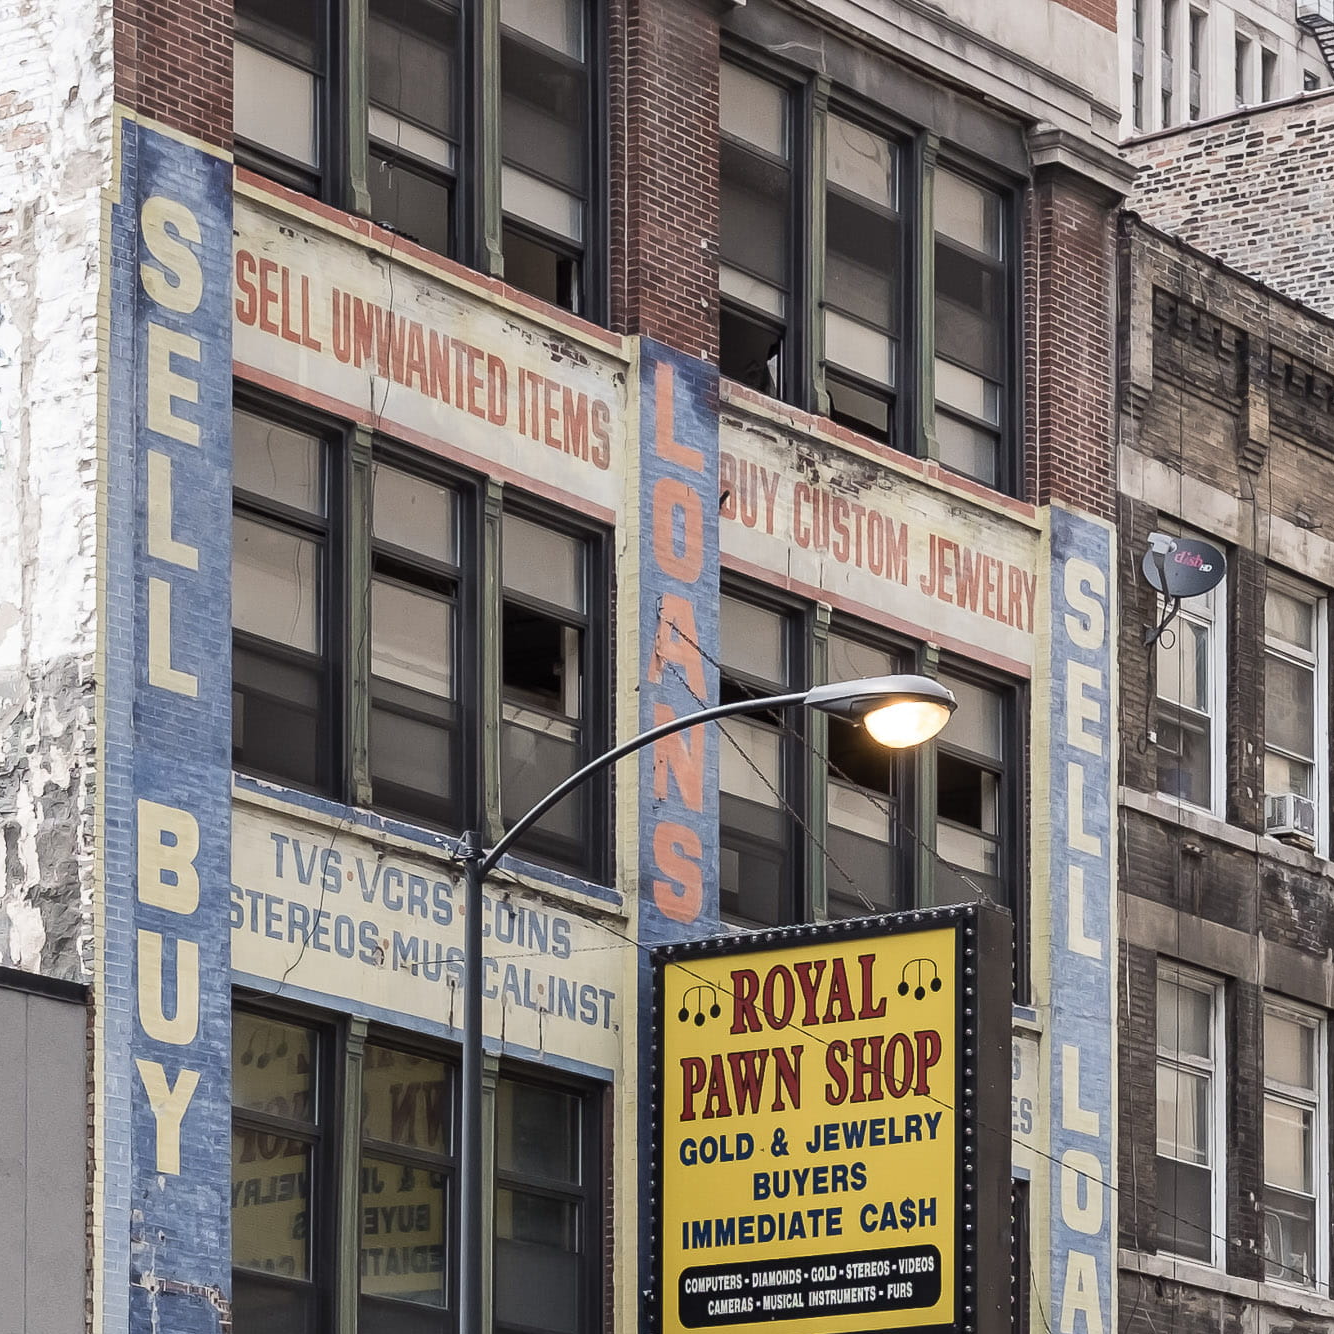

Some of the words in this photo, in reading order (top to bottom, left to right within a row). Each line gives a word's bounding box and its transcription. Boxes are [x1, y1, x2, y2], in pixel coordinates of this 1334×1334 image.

[234, 249, 323, 353] SELL
[332, 287, 509, 428] UNWANTED
[517, 366, 612, 471] ITEMS
[139, 195, 204, 698] SELL
[720, 450, 784, 537] BUY
[793, 480, 909, 588] CUSTOM
[919, 532, 1038, 635] JEWELRY
[1174, 551, 1204, 568] dish
[647, 359, 706, 924] LOANS
[1063, 556, 1107, 960] SELL
[269, 831, 343, 896] TVS
[352, 859, 454, 926] VCRS
[481, 894, 573, 960] COINS
[135, 797, 202, 1176] BUY
[229, 883, 379, 967] STEREOS
[547, 980, 621, 1032] INST.
[728, 952, 888, 1036] ROYAL
[678, 1044, 805, 1123] PAWN
[824, 1029, 943, 1107] SHOP
[678, 1132, 755, 1167] GOLD
[770, 1126, 790, 1158] &
[805, 1110, 944, 1154] JEWELRY
[752, 1160, 868, 1201] BUYERS
[681, 1205, 844, 1251] IMMEDIATE
[858, 1195, 938, 1234] CA$H
[684, 1273, 743, 1295] COMPUTERS
[751, 1268, 803, 1289] DIAMONDS
[810, 1264, 838, 1283] GOLD
[845, 1259, 891, 1281] STEREOS
[898, 1255, 935, 1275] VIDEOS
[707, 1295, 755, 1317] CAMERAS
[762, 1292, 805, 1312] MUSICAL
[808, 1286, 877, 1308] INSTRUMENTS
[886, 1281, 914, 1300] FURS
